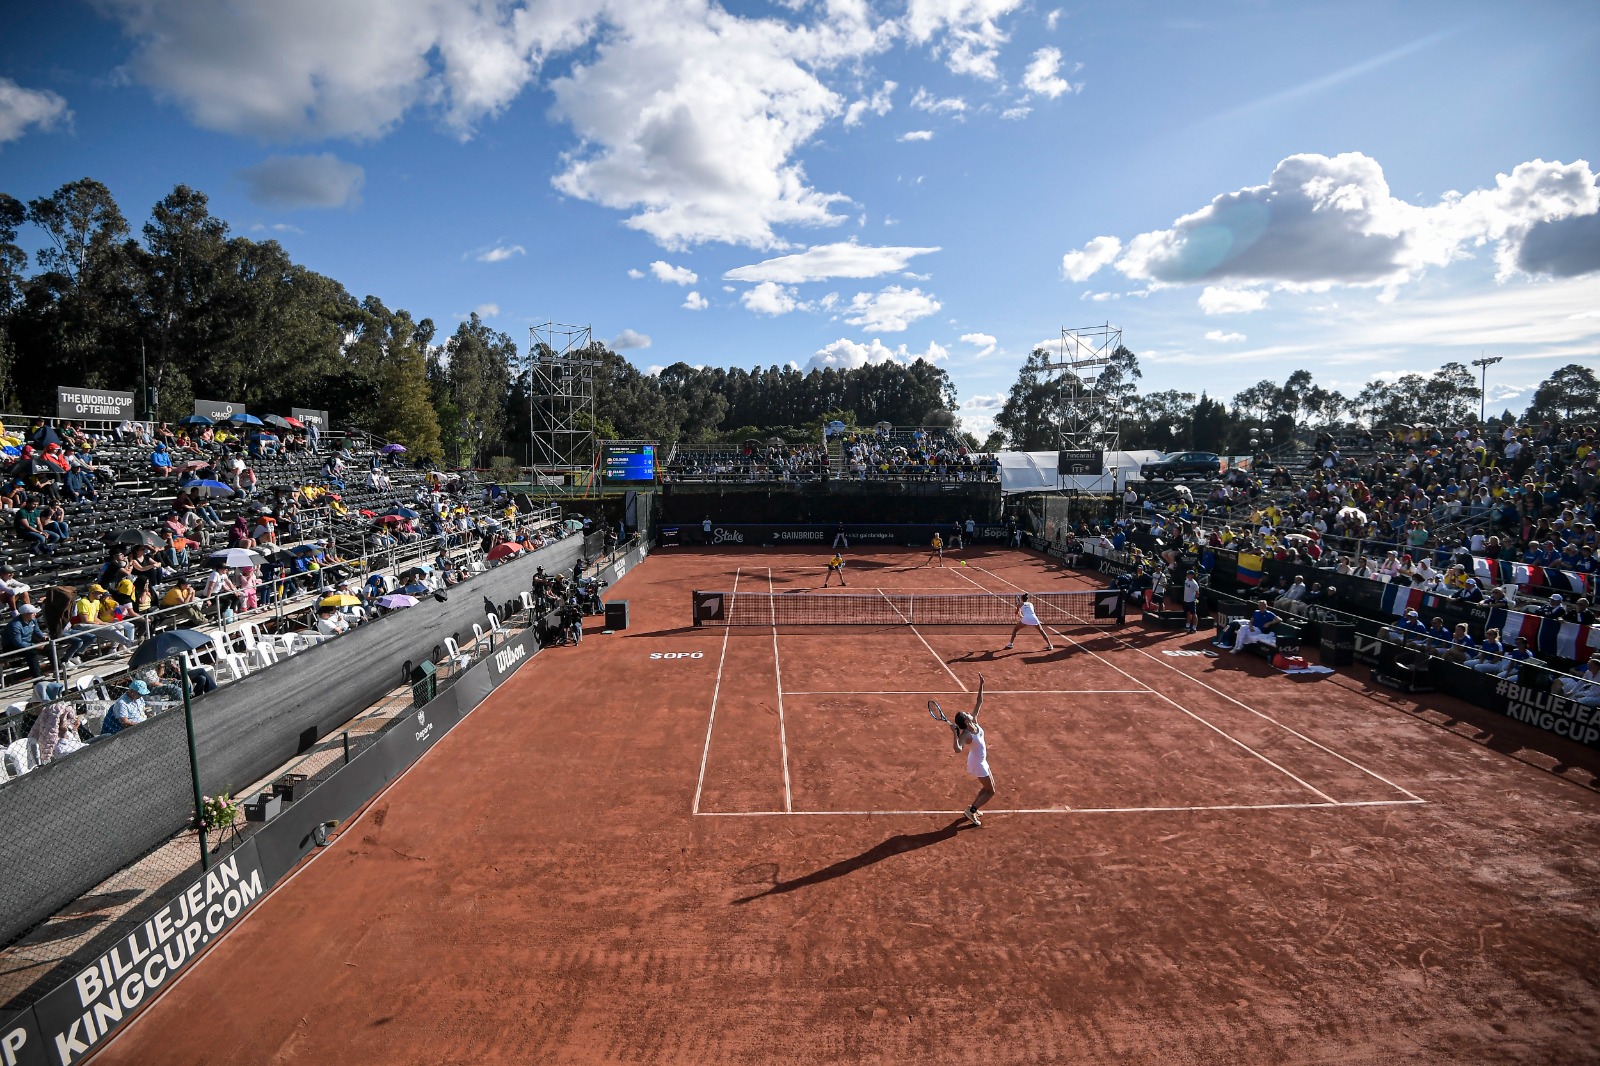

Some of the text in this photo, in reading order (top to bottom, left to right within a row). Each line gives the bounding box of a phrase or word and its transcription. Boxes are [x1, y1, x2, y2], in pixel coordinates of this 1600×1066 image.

[61, 393, 132, 406] THE WORLD CUP
[76, 404, 120, 415] OF TENNIS
[713, 527, 744, 544] Stake
[781, 531, 824, 540] GAINBRIDGE
[1470, 608, 1486, 619] FRA
[495, 643, 526, 673] Wilson
[649, 650, 704, 660] SOPÓ
[1505, 700, 1600, 745] KINGCUP
[54, 868, 263, 1066] KINGCUP.COM
